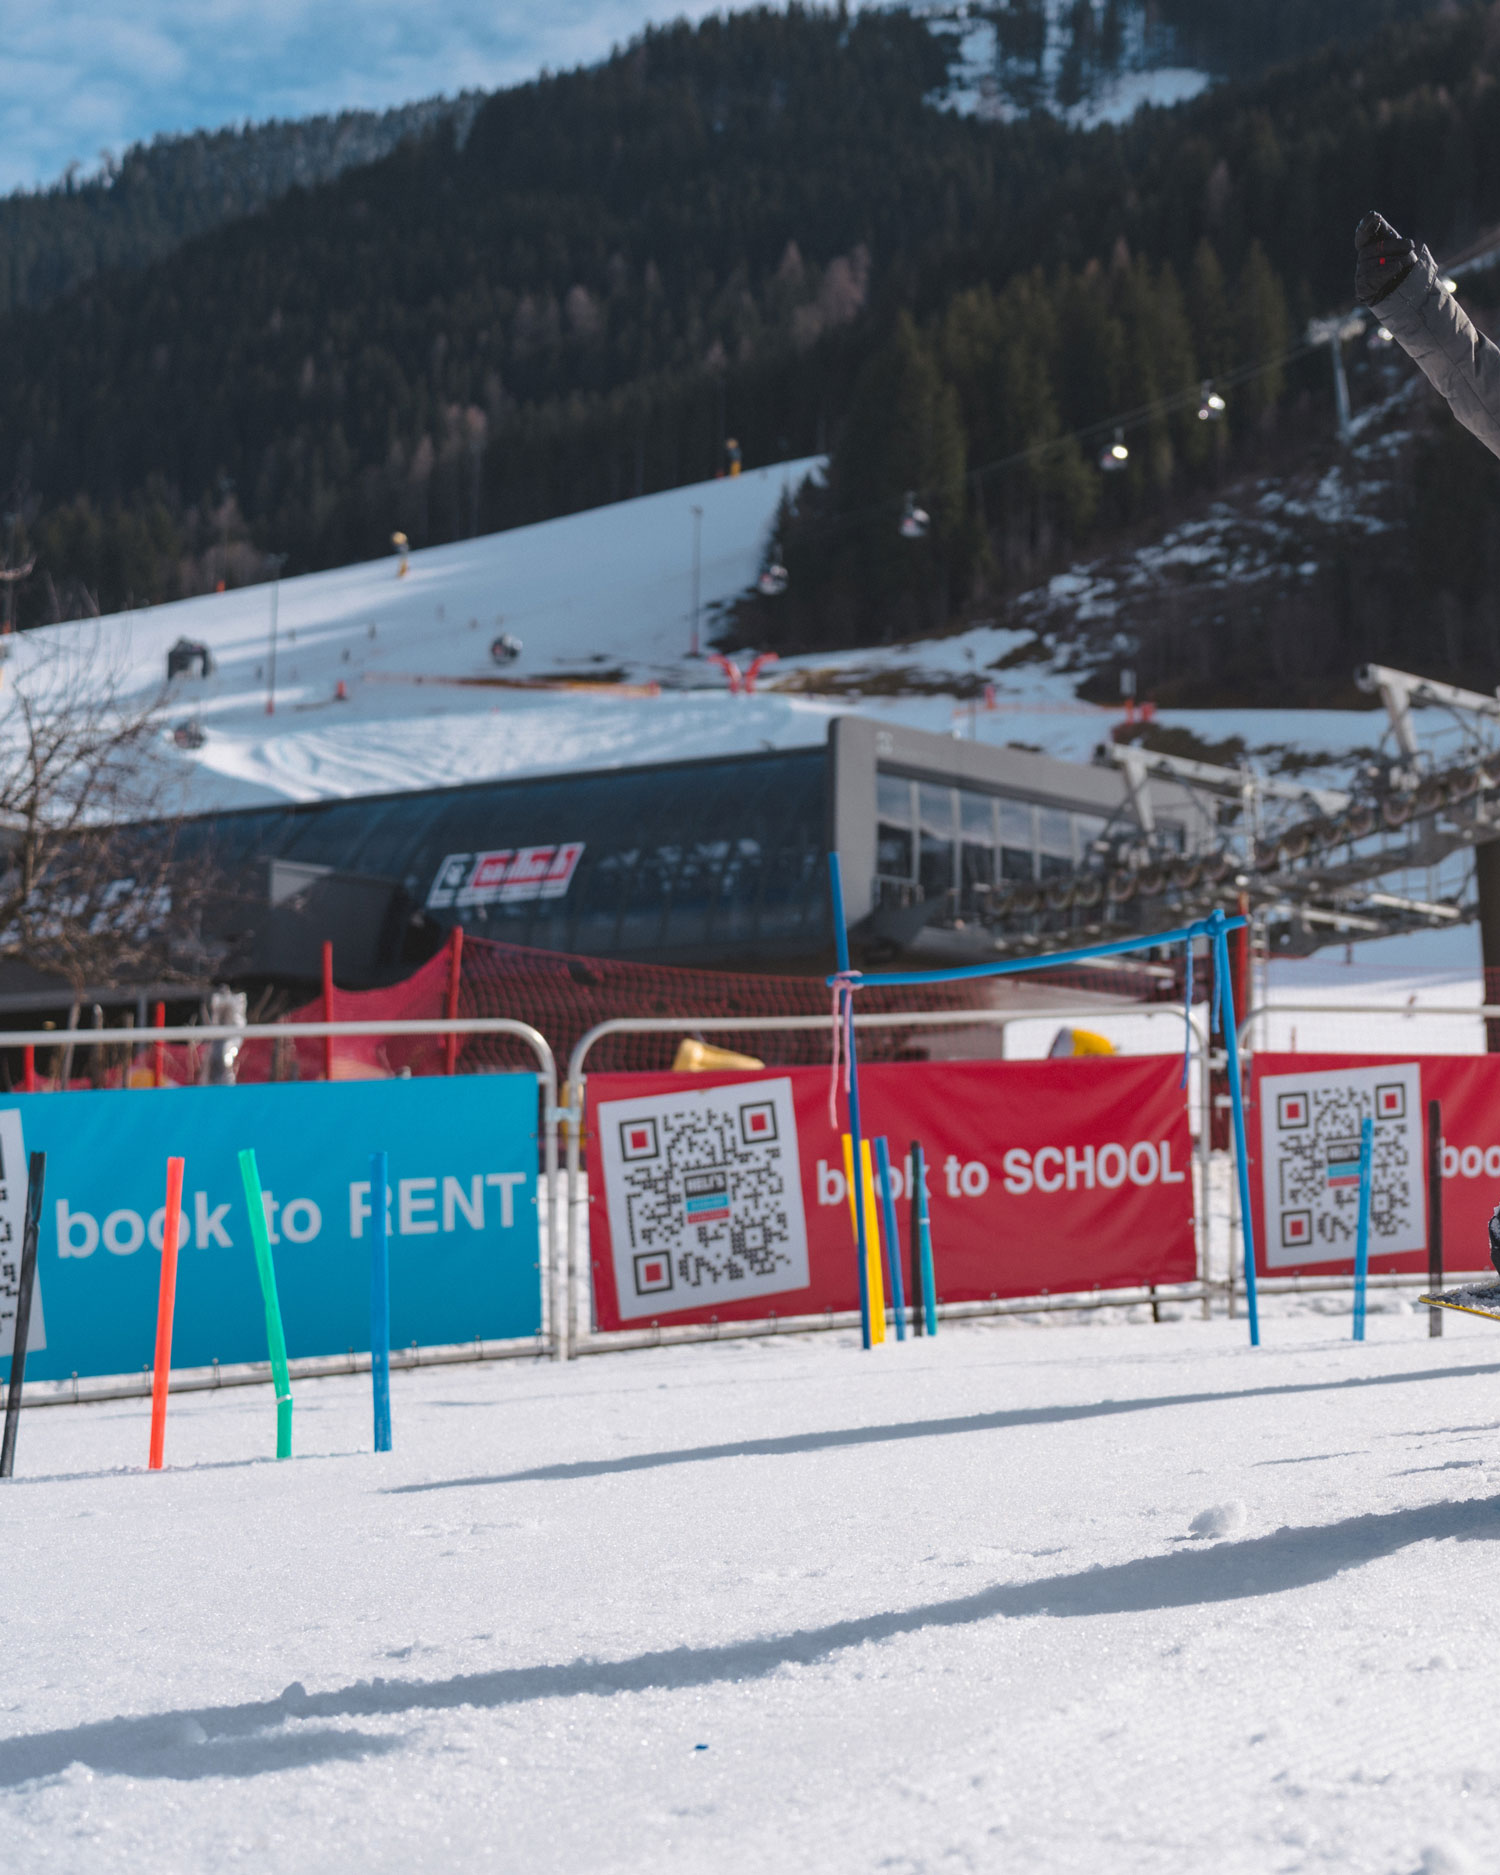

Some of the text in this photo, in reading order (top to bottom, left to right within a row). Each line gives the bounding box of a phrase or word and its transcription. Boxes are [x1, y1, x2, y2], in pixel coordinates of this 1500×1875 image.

[943, 1154, 990, 1198] to
[1002, 1140, 1186, 1195] SCHOOL
[56, 1191, 233, 1259] book
[262, 1191, 323, 1244] to
